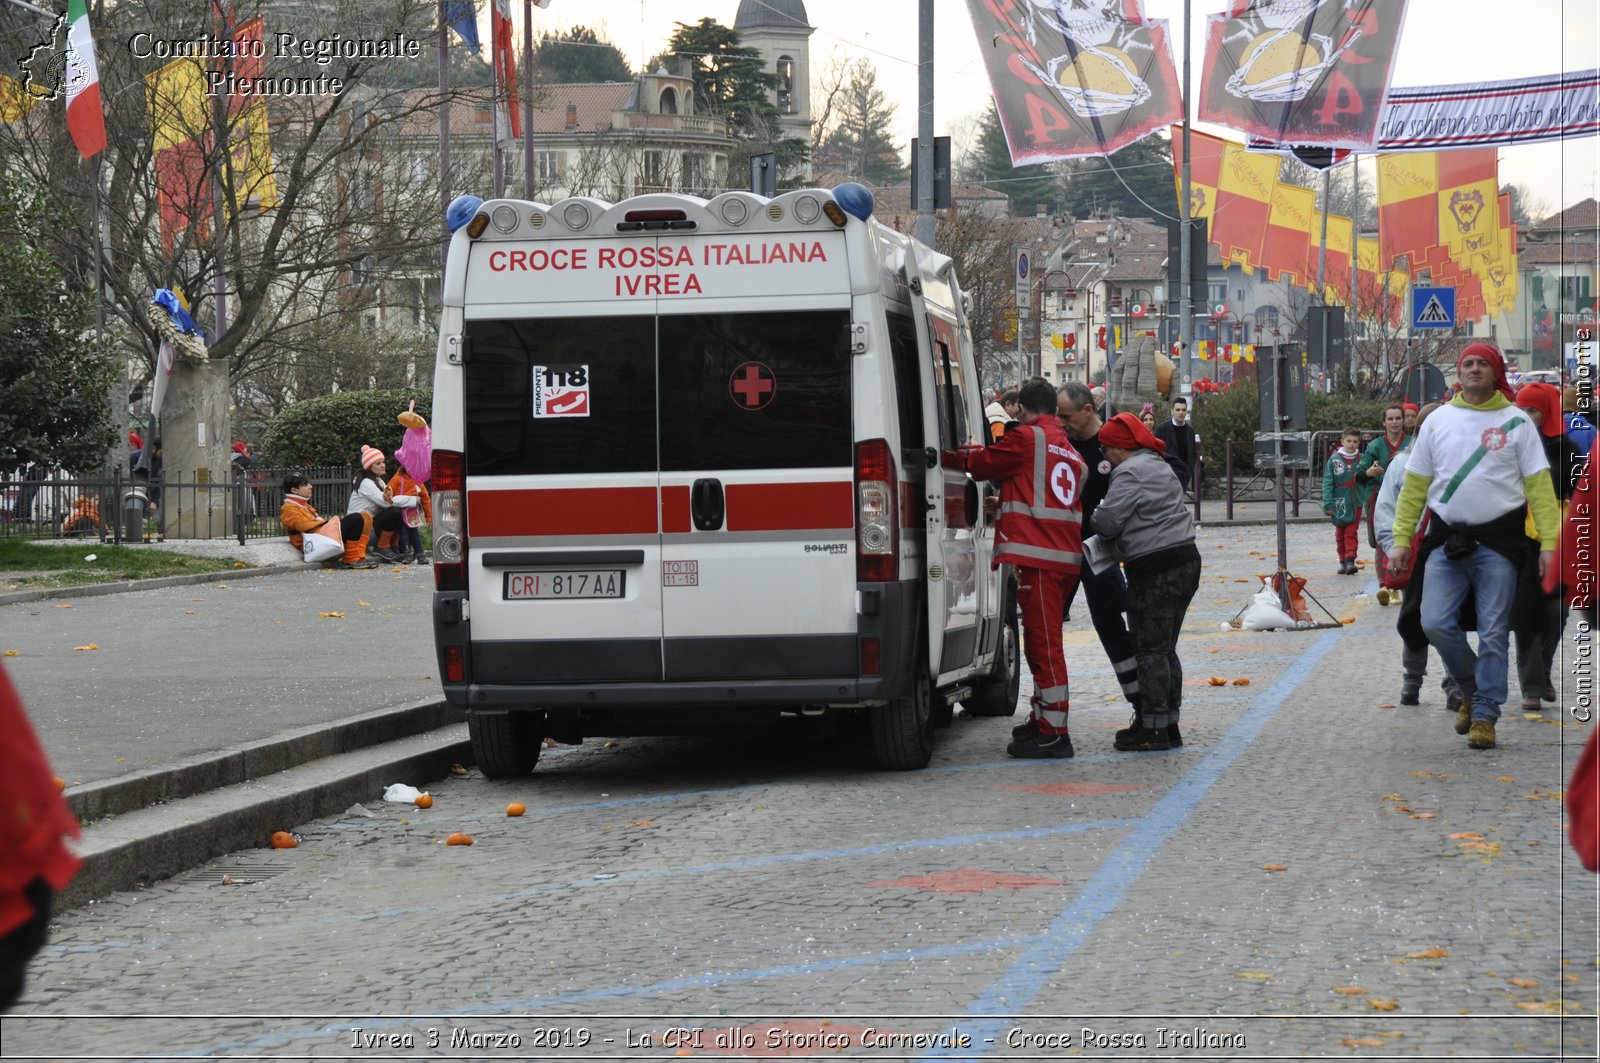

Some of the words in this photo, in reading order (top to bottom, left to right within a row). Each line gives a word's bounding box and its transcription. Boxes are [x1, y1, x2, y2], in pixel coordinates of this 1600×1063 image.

[1407, 103, 1467, 137] schiena
[1472, 115, 1480, 132] e
[1548, 89, 1577, 125] nel
[489, 249, 587, 272] CROCE
[598, 245, 694, 269] ROSSA
[703, 241, 827, 266] ITALIANA
[615, 273, 703, 297] IVREA
[541, 367, 588, 387] 118
[666, 562, 680, 573] TO
[684, 562, 695, 573] 10
[511, 575, 540, 596] CRI
